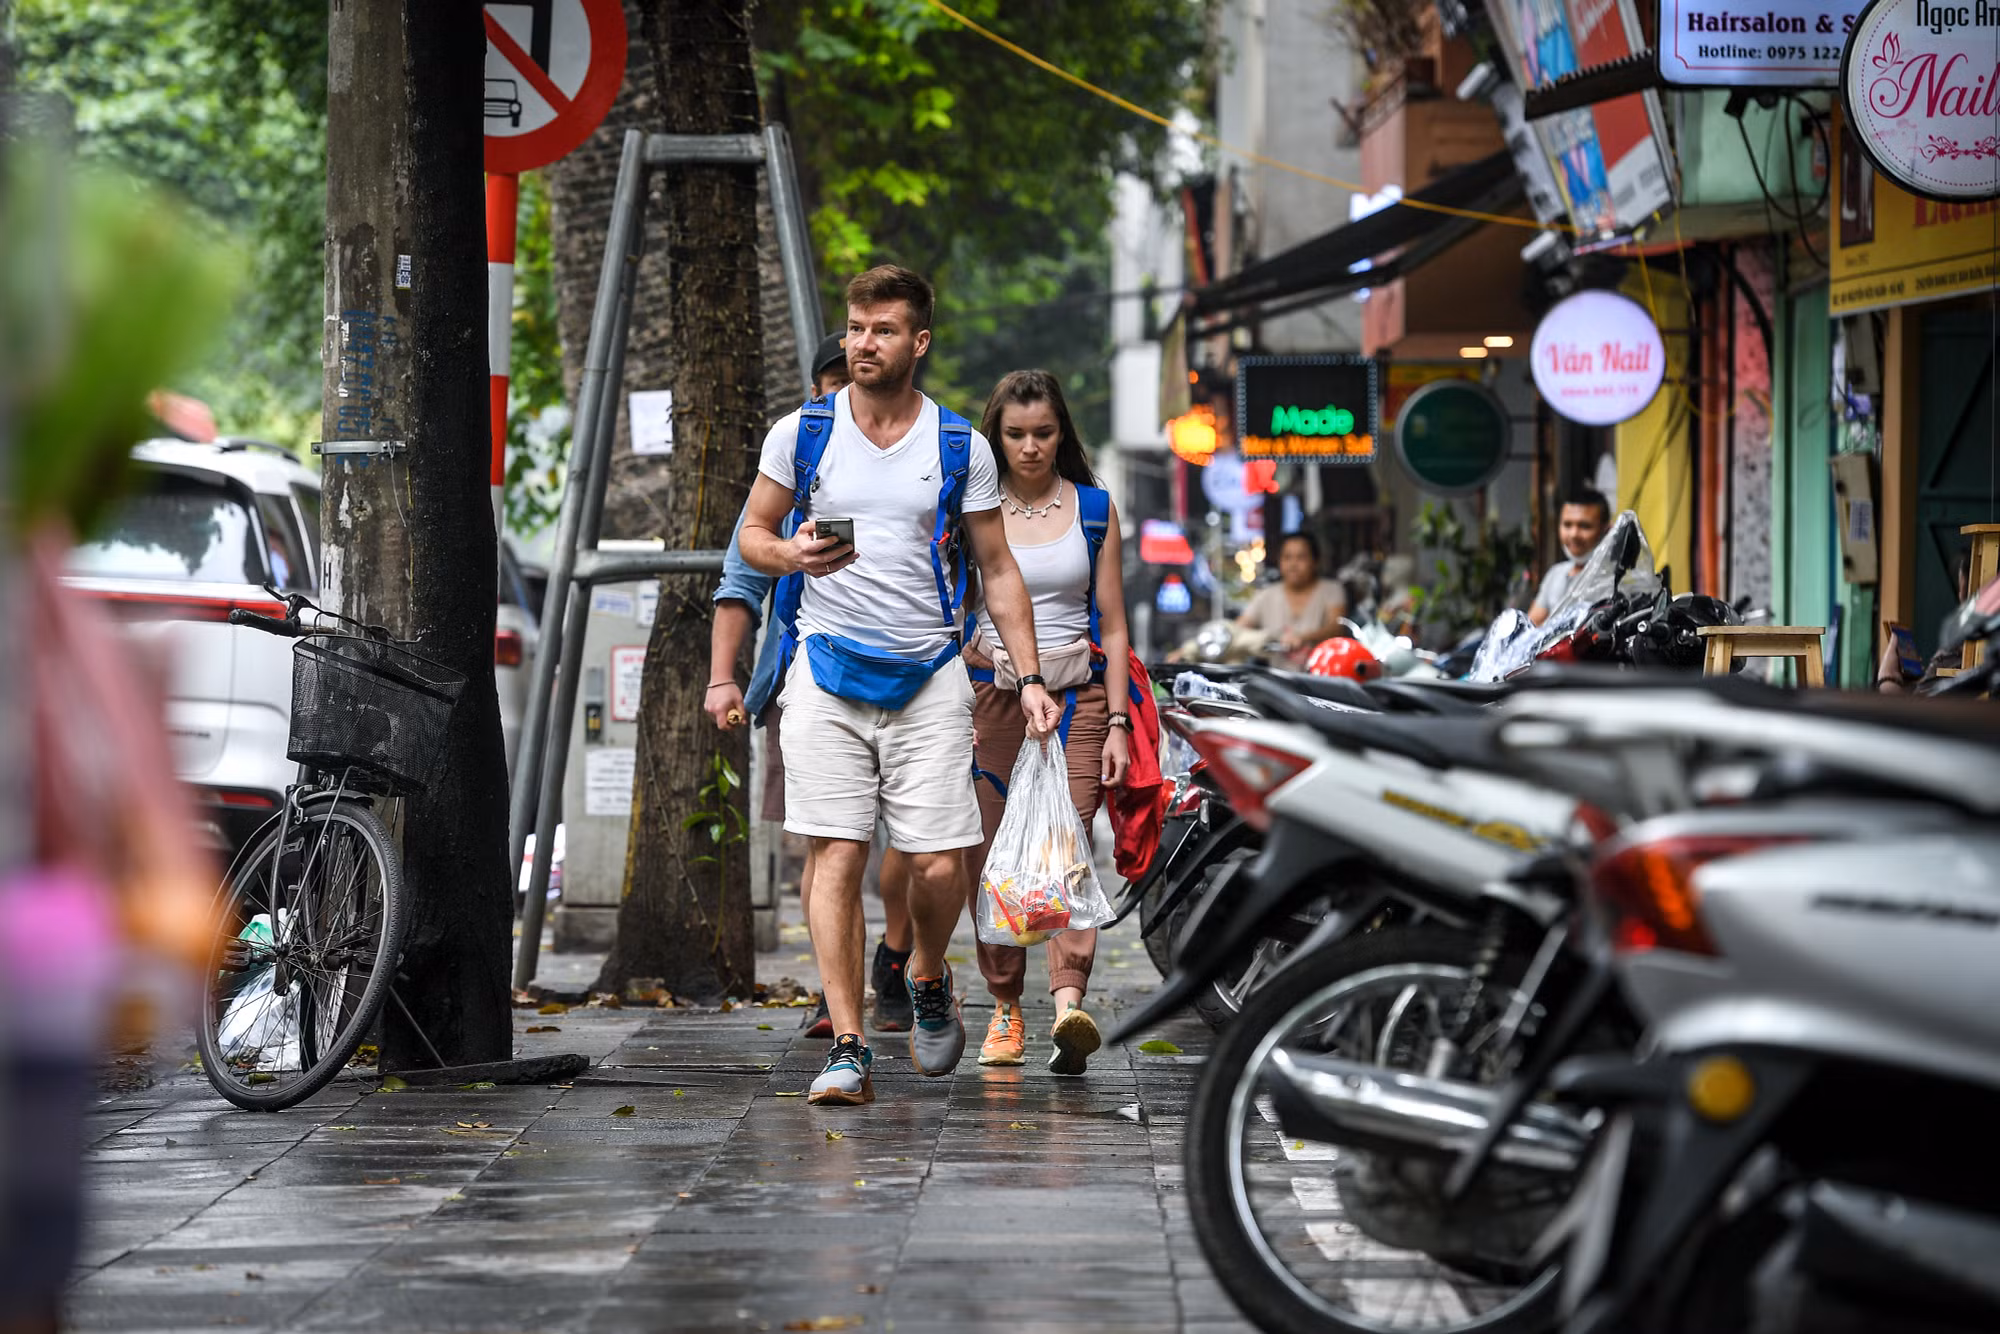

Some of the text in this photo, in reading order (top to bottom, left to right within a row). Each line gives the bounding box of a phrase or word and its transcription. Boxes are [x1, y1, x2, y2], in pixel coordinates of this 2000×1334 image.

[1688, 11, 1856, 33] Hairsalon & S
[1916, 0, 1969, 34] Ngọc
[1698, 44, 1841, 59] Hotline: 0975 122
[1869, 53, 2000, 119] Nail
[1600, 340, 1651, 374] Nail
